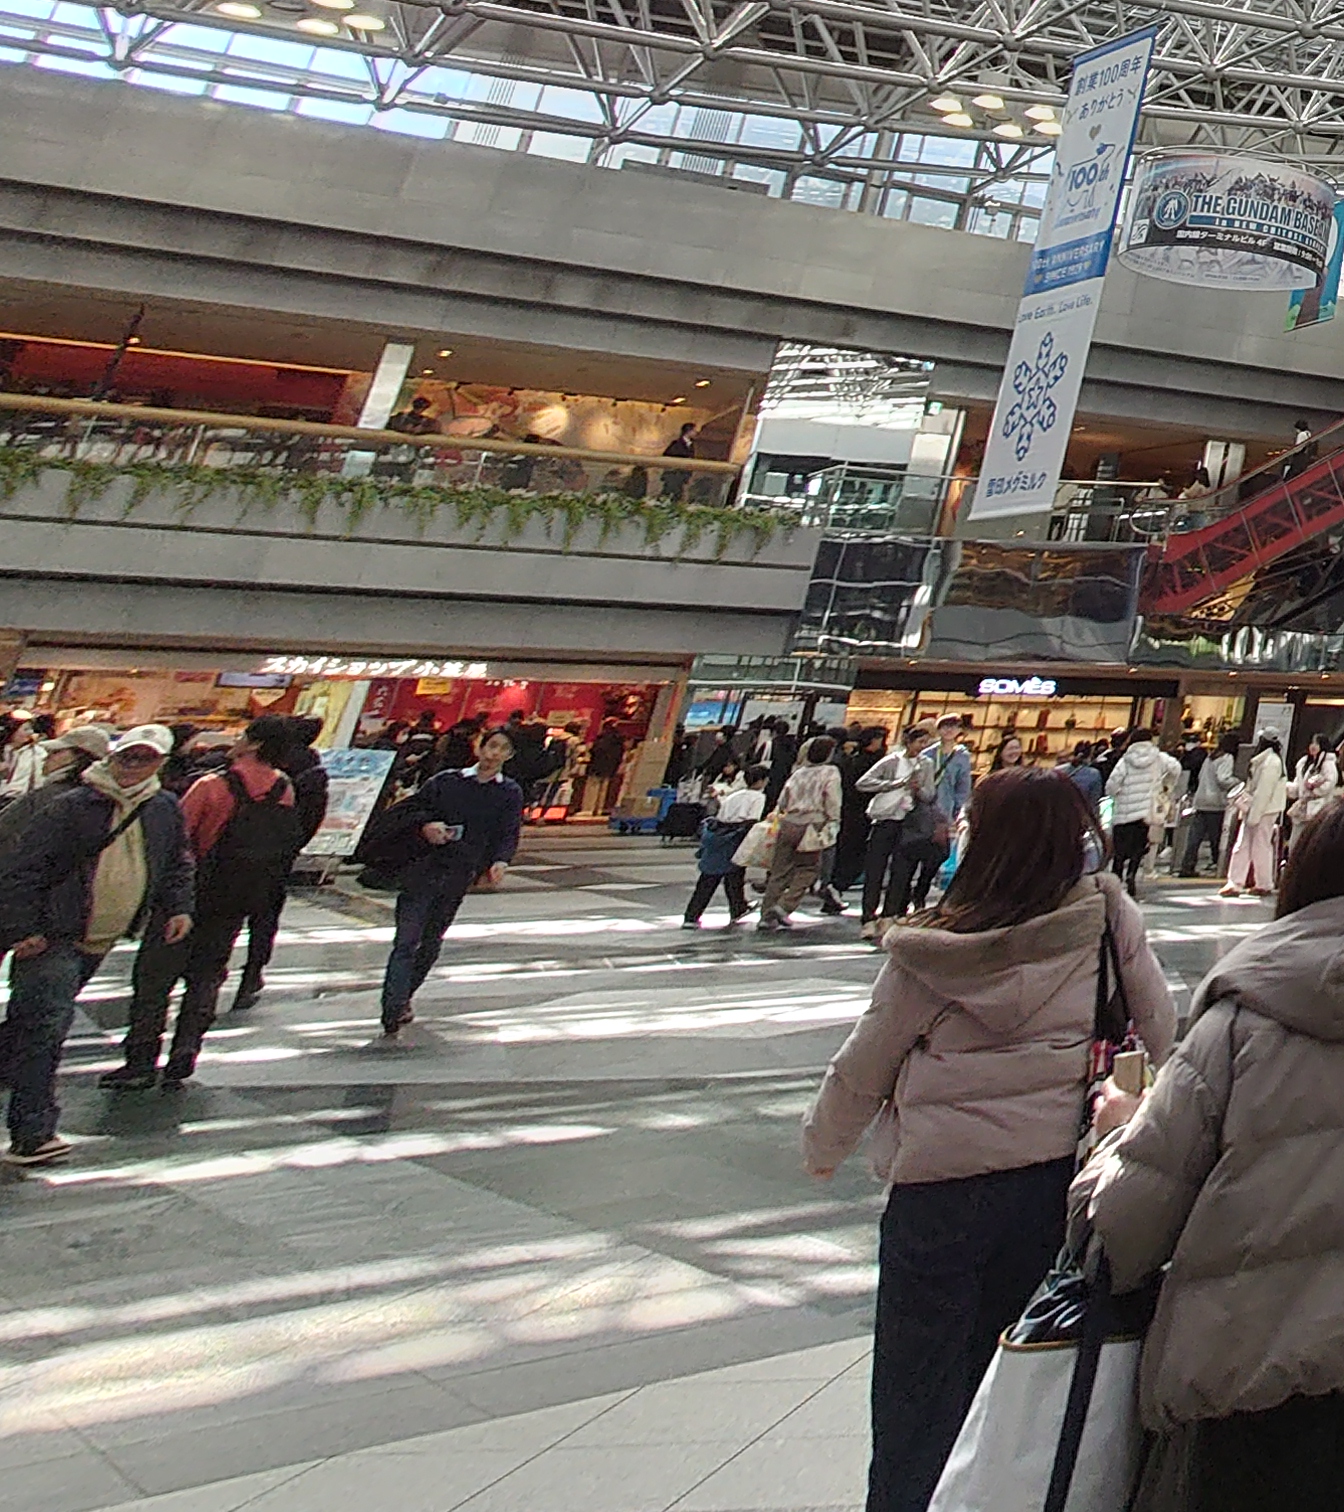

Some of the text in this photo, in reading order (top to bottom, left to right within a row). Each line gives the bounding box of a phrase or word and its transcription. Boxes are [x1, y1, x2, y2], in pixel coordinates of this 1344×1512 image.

[1074, 55, 1143, 97] 創業100周年
[1078, 89, 1124, 121] ありがとう
[1193, 194, 1319, 236] THE GUNDAM BASE
[986, 470, 1047, 498] 雪印メグミルク
